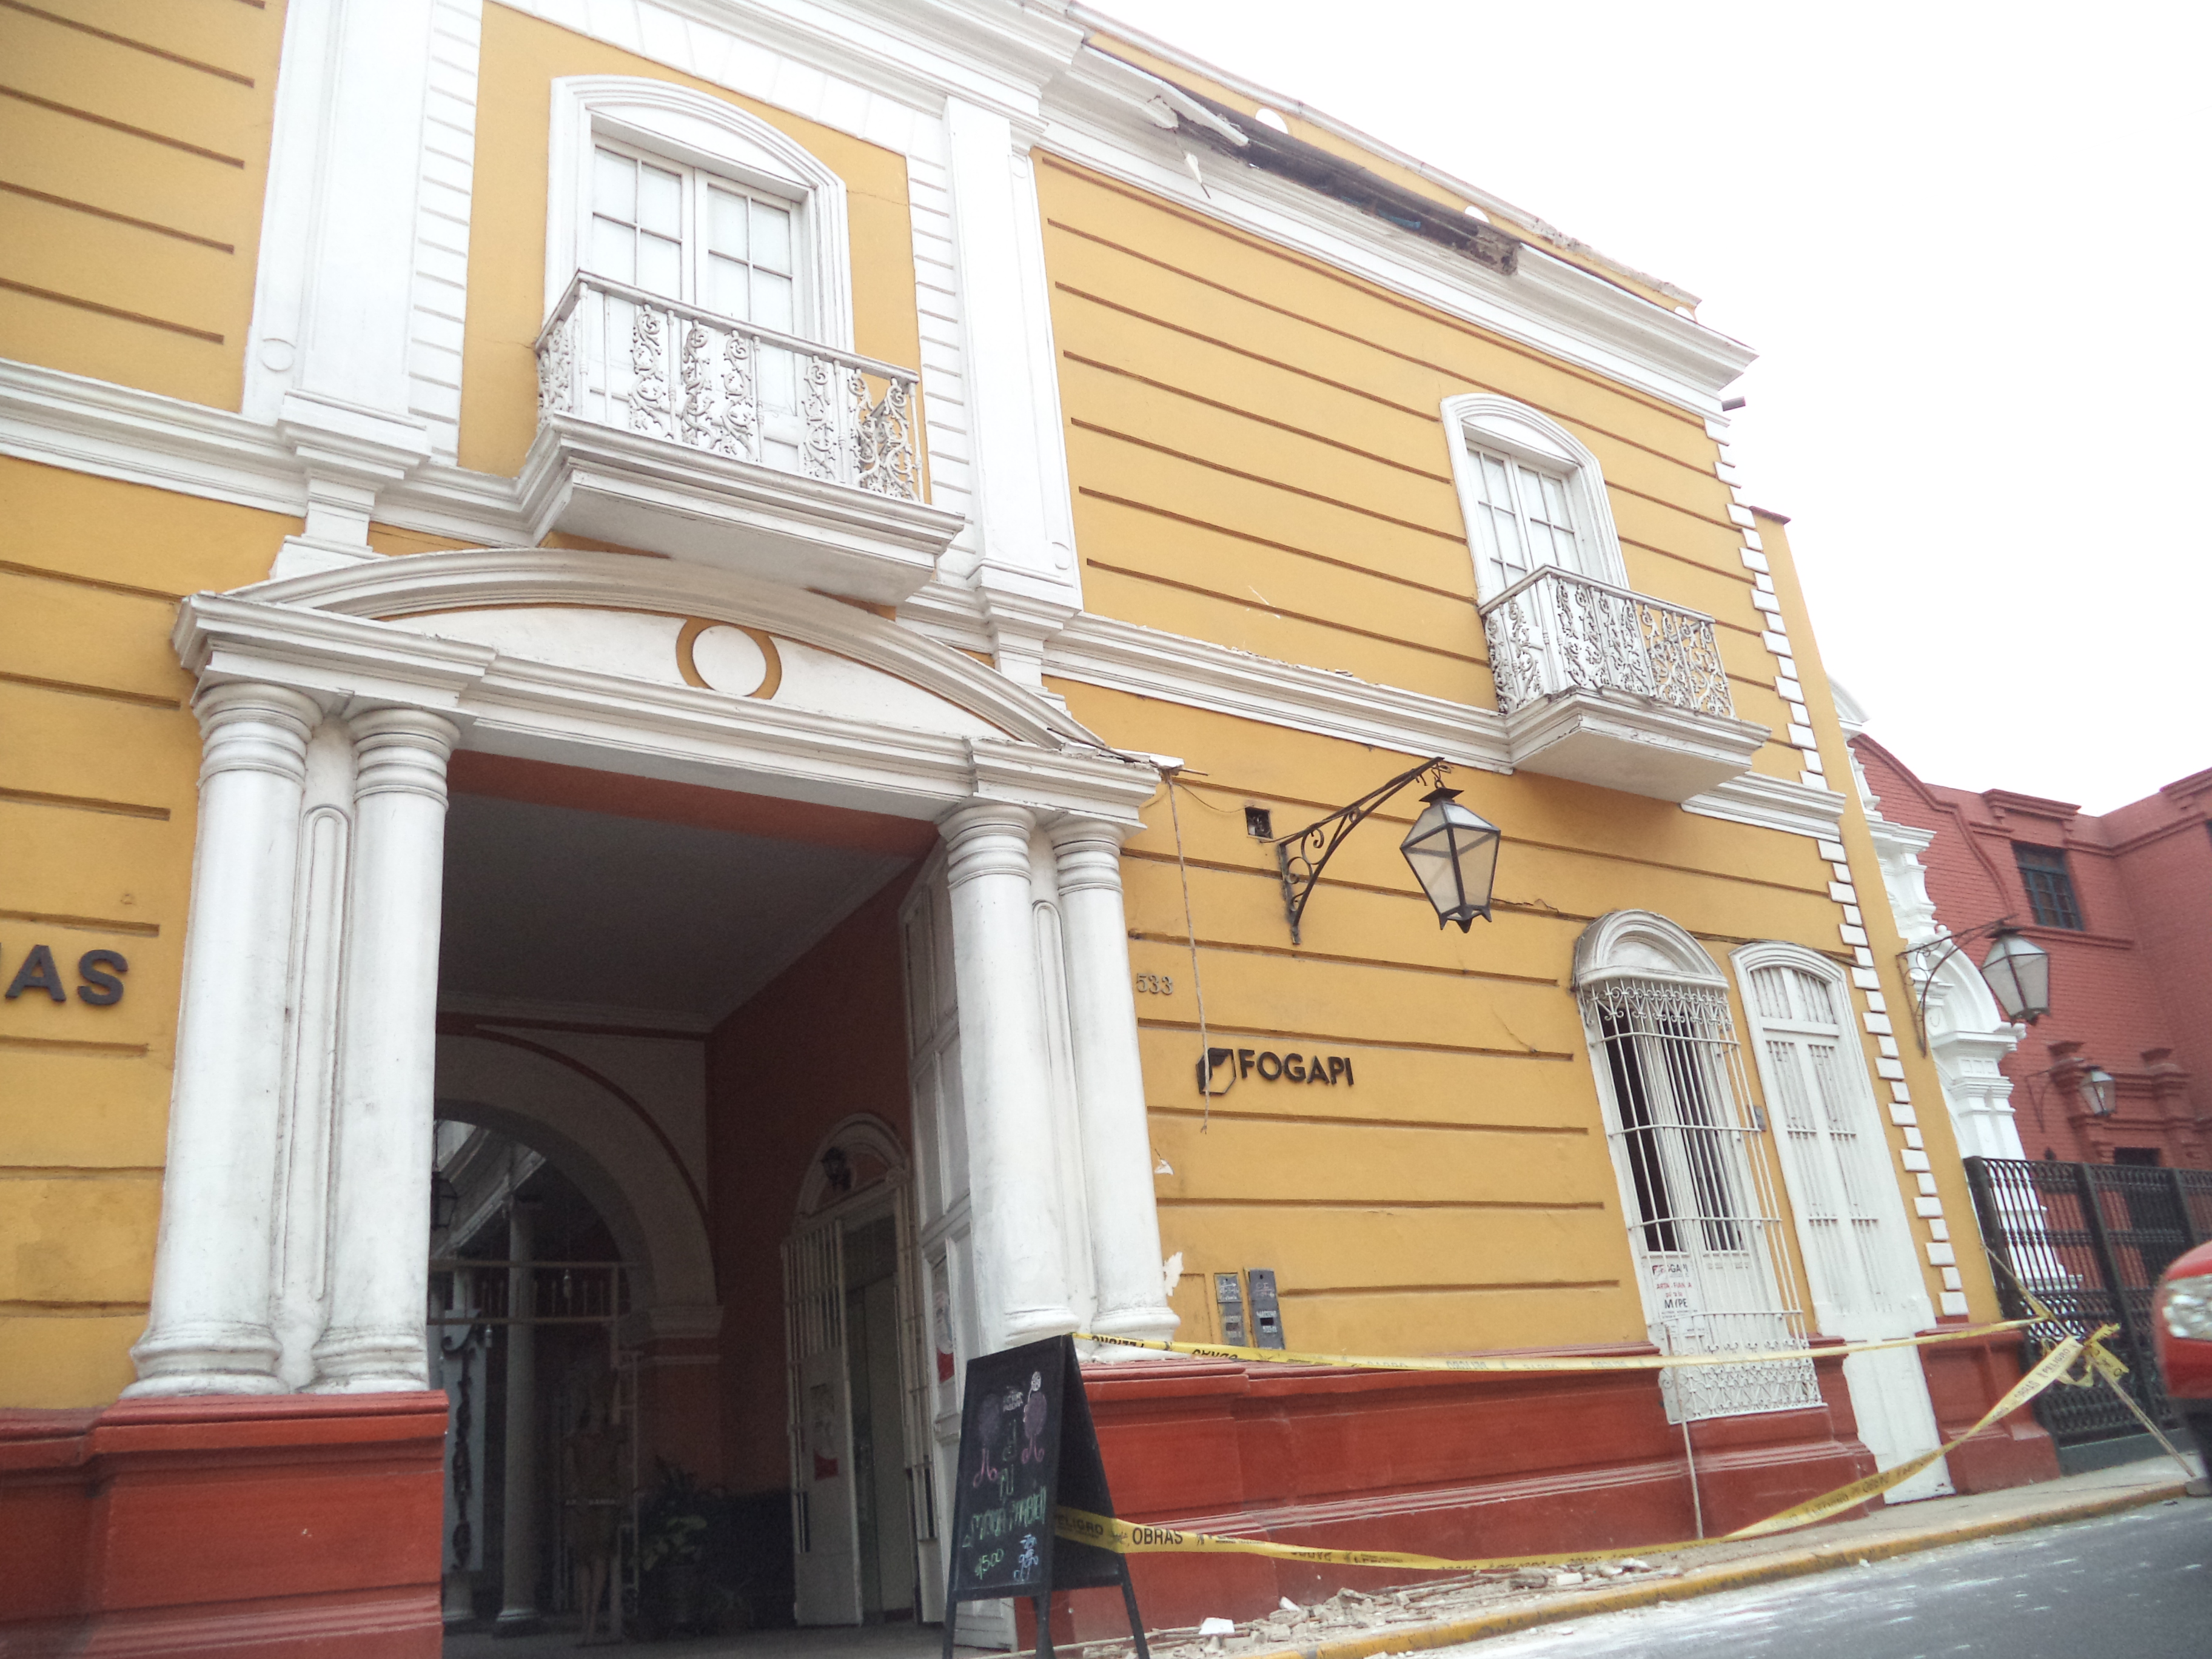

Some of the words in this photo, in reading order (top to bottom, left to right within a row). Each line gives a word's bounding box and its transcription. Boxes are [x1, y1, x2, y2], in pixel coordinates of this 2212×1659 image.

[0, 943, 129, 1006] AS
[1136, 972, 1174, 996] 533
[1238, 1049, 1354, 1087] FOGAPI
[1132, 1527, 1183, 1545] OBRAS
